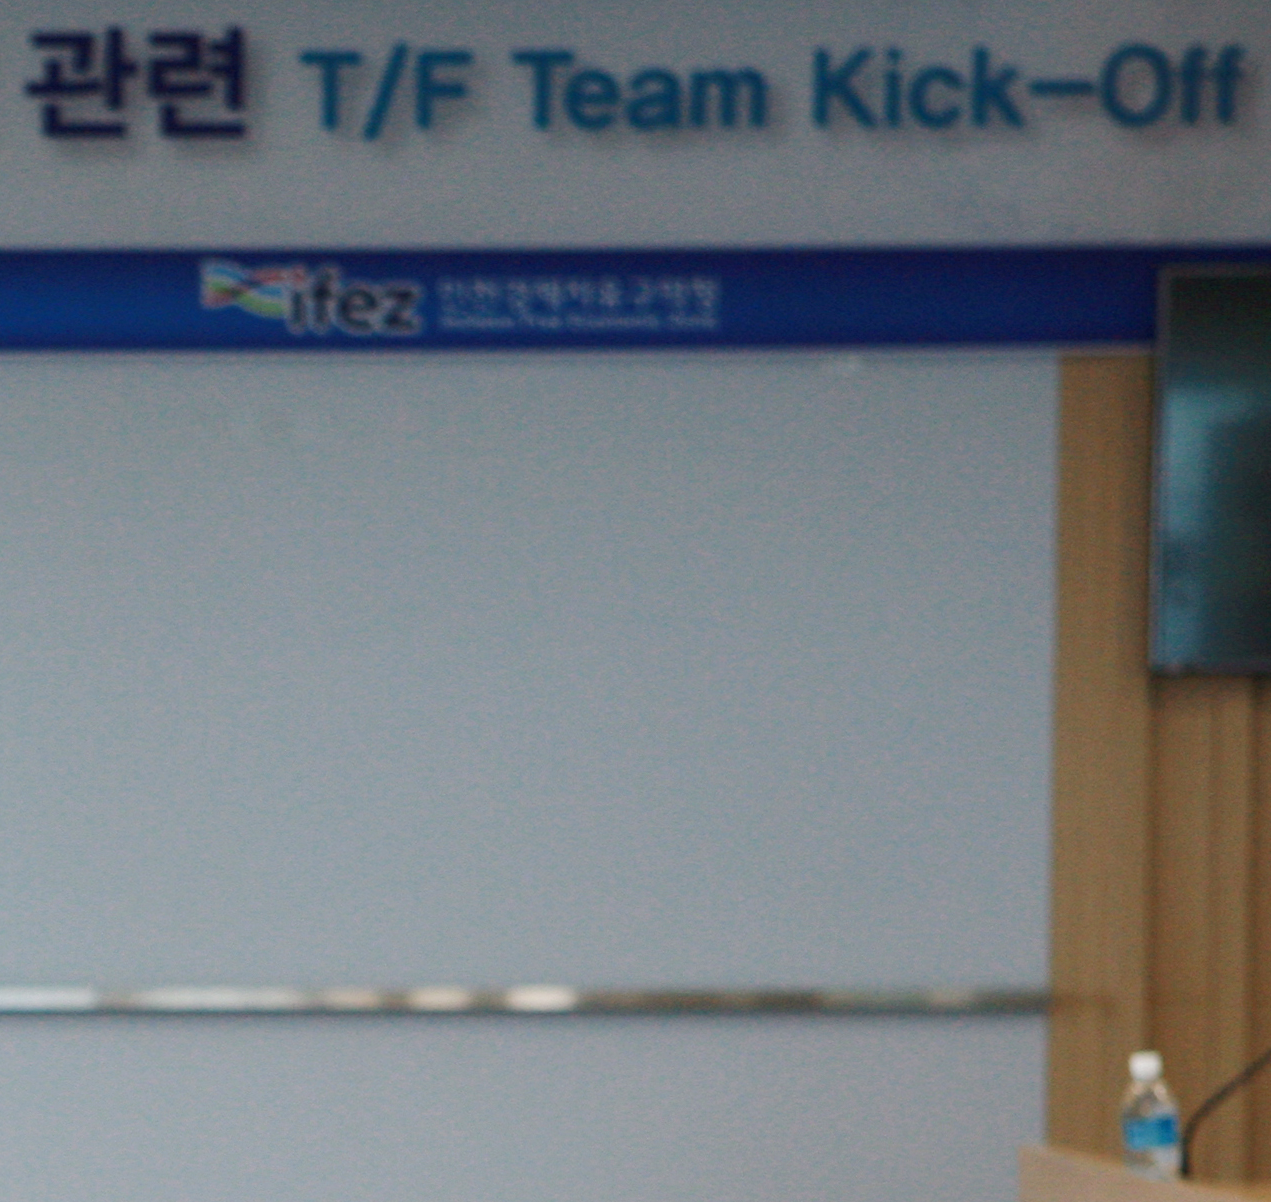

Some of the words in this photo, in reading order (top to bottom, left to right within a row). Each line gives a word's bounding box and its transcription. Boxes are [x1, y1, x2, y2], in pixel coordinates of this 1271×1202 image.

[23, 25, 246, 139] 관련
[297, 41, 473, 142] T/F
[509, 49, 770, 131] Team
[811, 41, 1247, 130] Kick-Off
[285, 265, 426, 336] ifez
